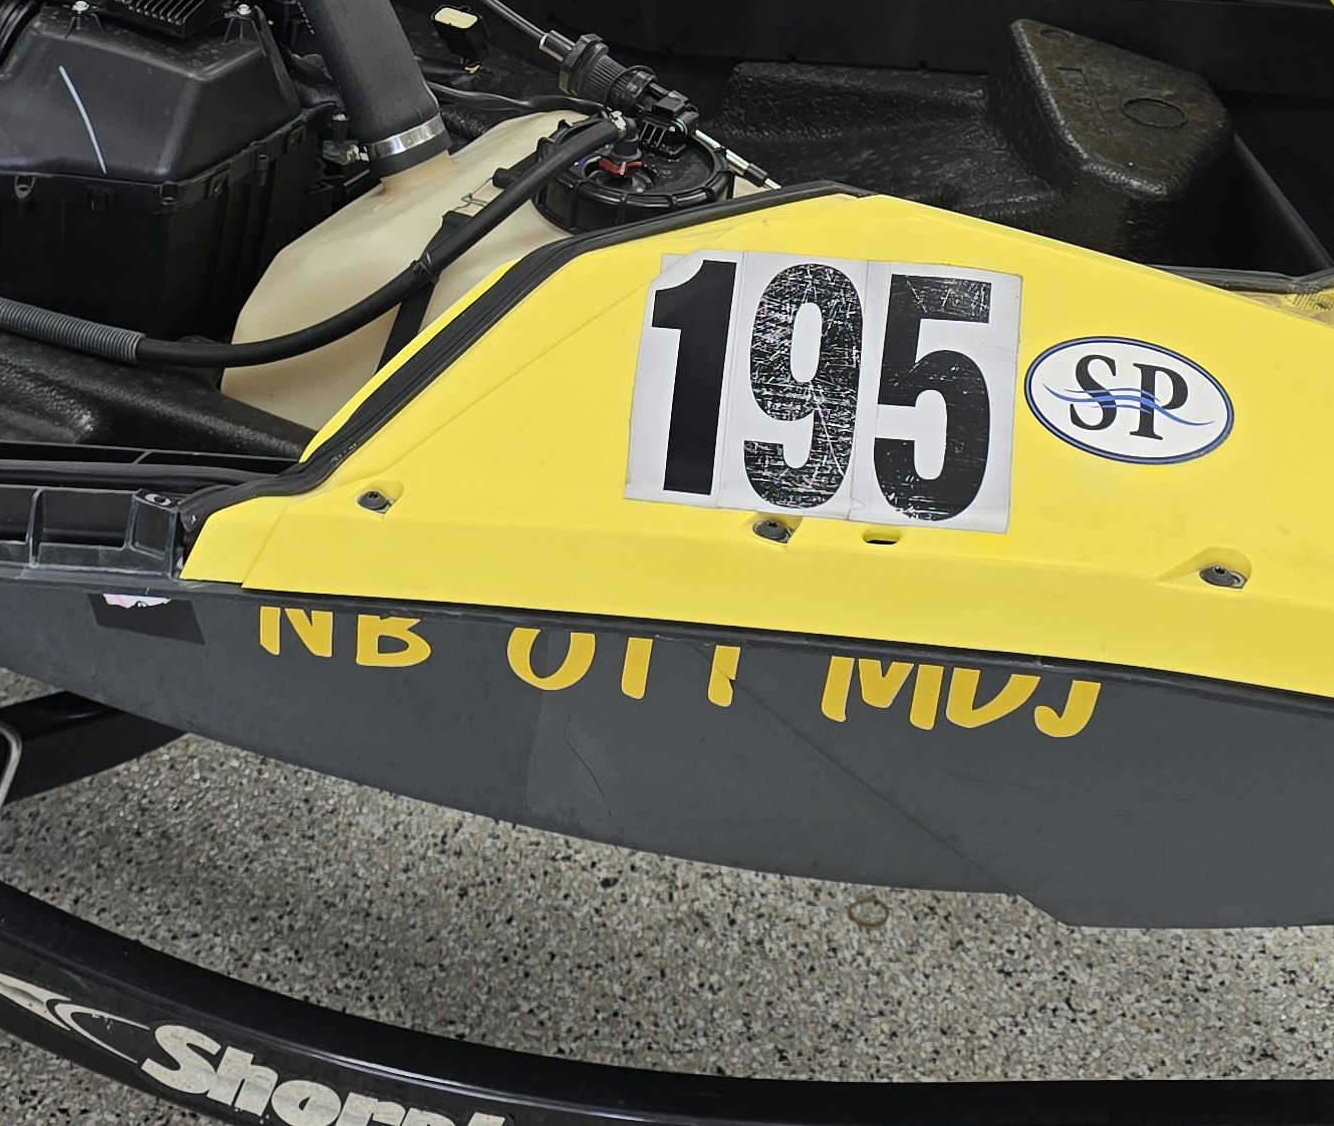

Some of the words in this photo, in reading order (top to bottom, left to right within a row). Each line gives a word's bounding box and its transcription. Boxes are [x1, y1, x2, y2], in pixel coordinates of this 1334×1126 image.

[651, 258, 993, 522] 195
[1069, 353, 1189, 441] SP
[259, 605, 432, 668] NB
[140, 1024, 506, 1126] Shor
